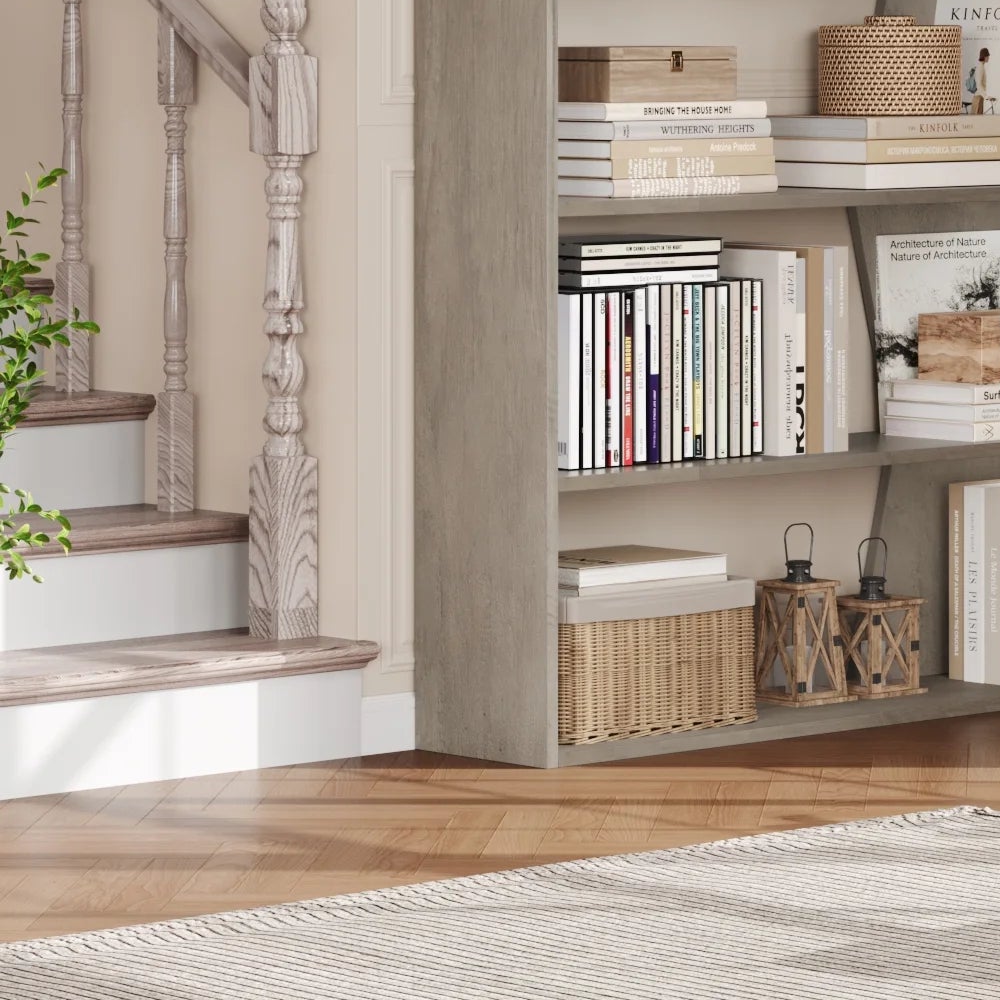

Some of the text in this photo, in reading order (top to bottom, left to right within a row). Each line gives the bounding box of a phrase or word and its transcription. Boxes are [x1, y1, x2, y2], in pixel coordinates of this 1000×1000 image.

[643, 105, 733, 116] BRINGING THE HOUSE HOME
[660, 124, 755, 135] WUTHERING HEIGHTS
[919, 122, 959, 133] KINFOLK
[890, 237, 986, 249] Architecture of Nature
[890, 249, 987, 262] Nature of Architecture
[983, 390, 1000, 400] Surf
[968, 560, 978, 652] LES PLAISIRS
